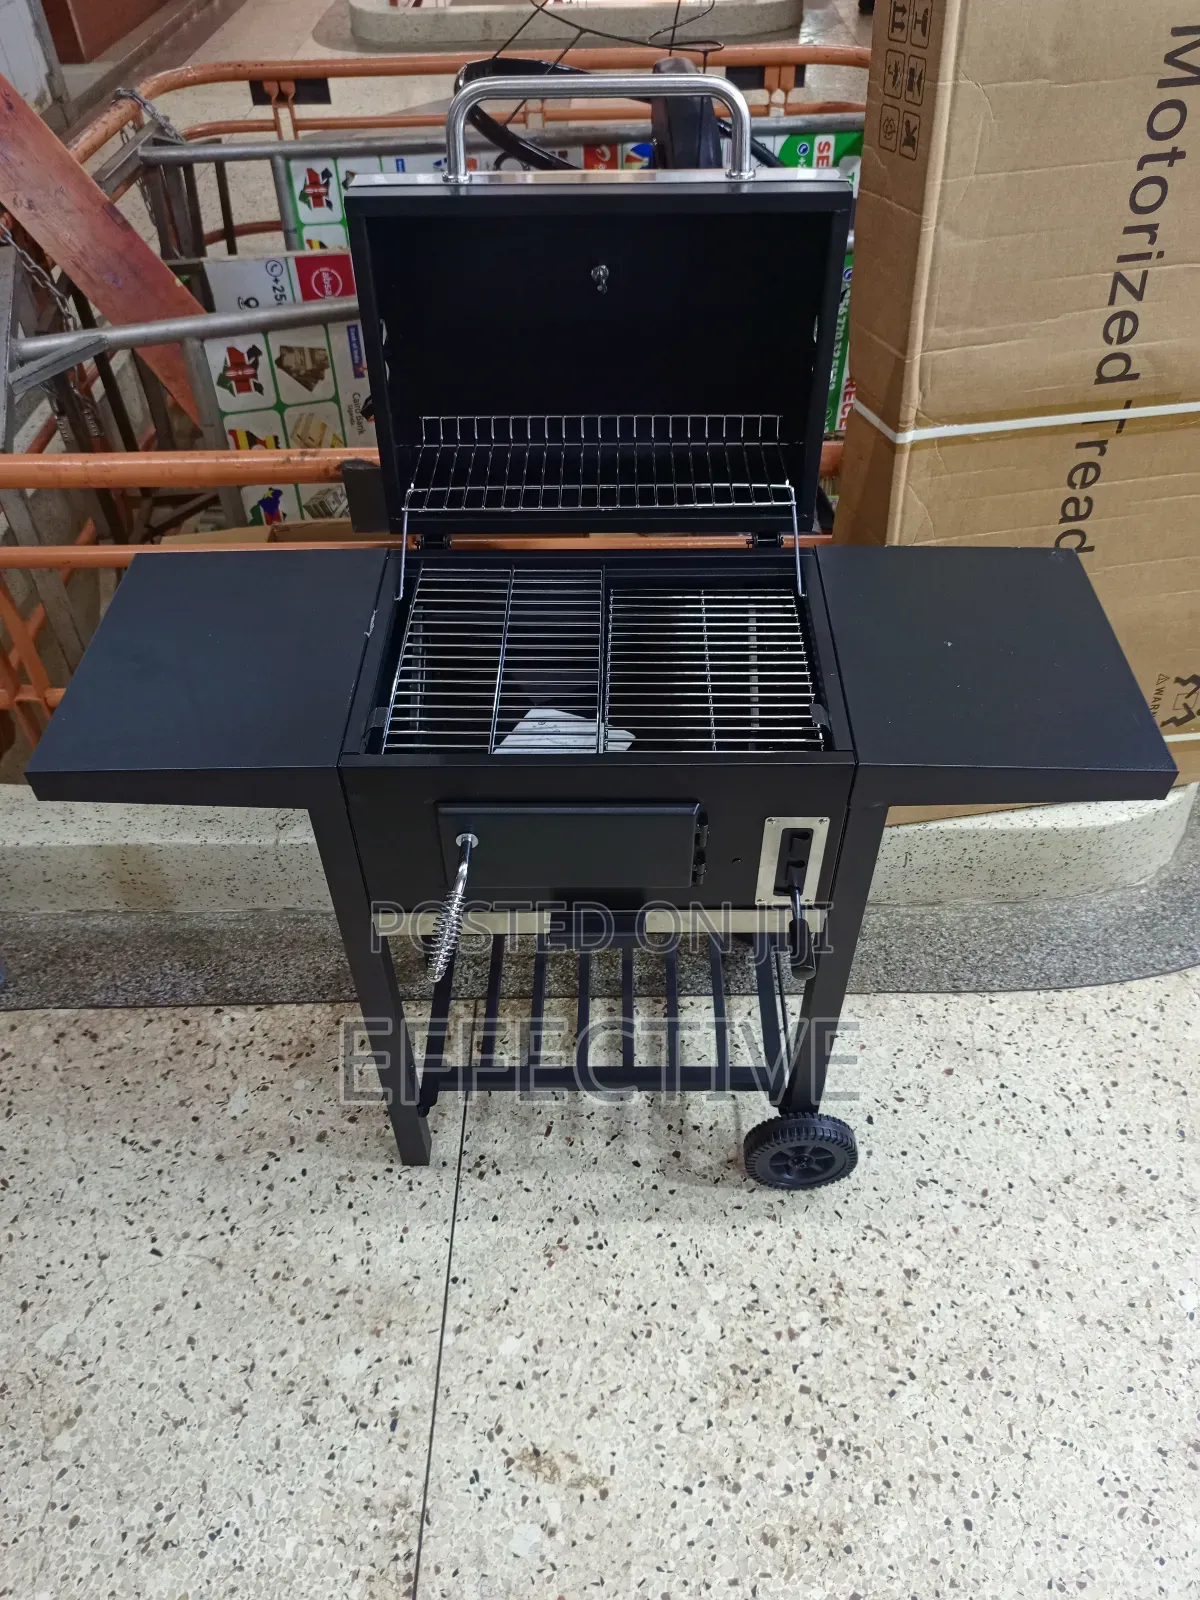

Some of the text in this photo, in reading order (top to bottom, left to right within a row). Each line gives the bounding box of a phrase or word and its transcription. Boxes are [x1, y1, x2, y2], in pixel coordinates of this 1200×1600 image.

[1093, 25, 1200, 386] Motorized
[272, 277, 286, 306] +25
[321, 271, 333, 296] absa
[352, 392, 367, 435] Cairo Bank
